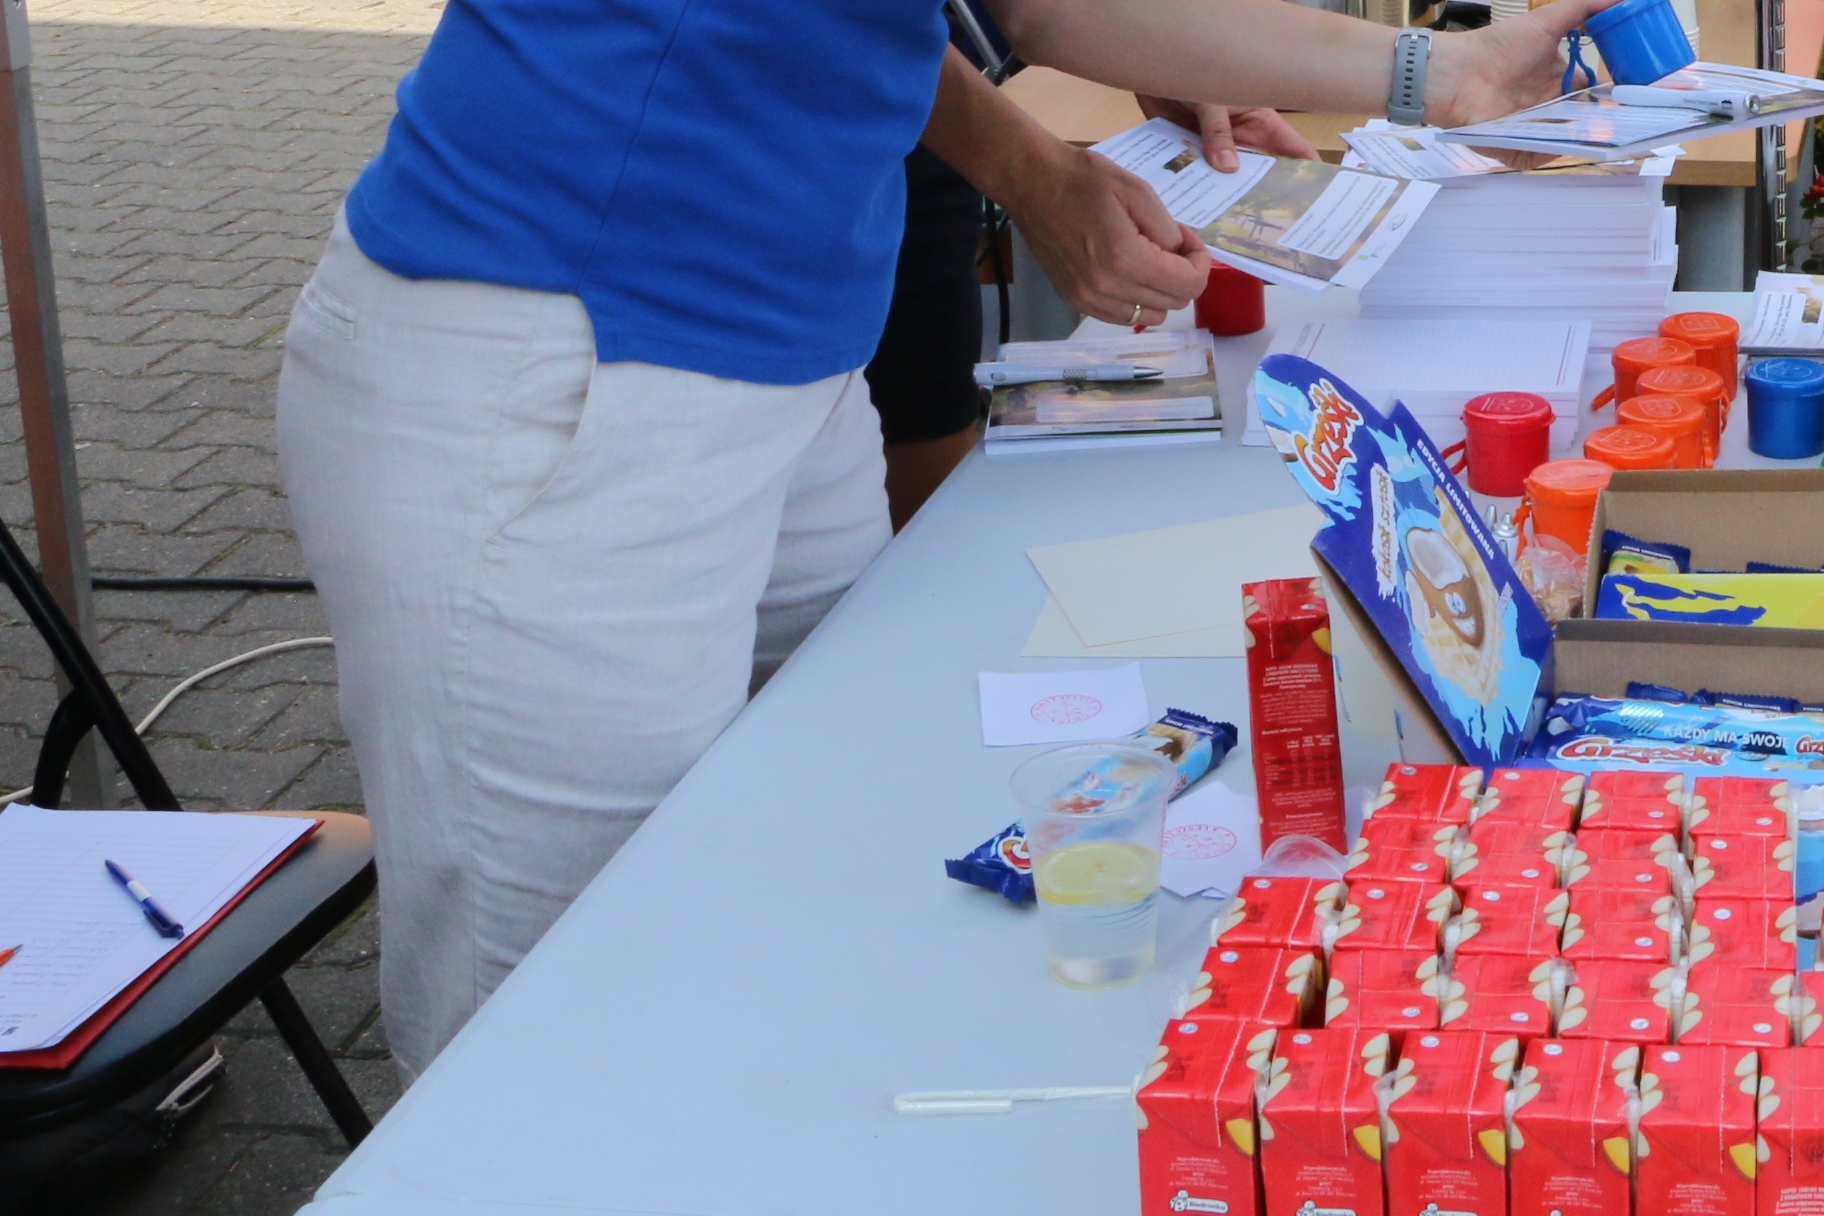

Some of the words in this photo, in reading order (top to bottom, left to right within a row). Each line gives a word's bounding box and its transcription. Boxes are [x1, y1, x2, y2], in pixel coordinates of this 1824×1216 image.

[1416, 439, 1446, 483] EDYCJA
[1445, 483, 1495, 560] LIMITOWANA
[1714, 730, 1738, 743] MA
[1742, 733, 1790, 749] SWOJE
